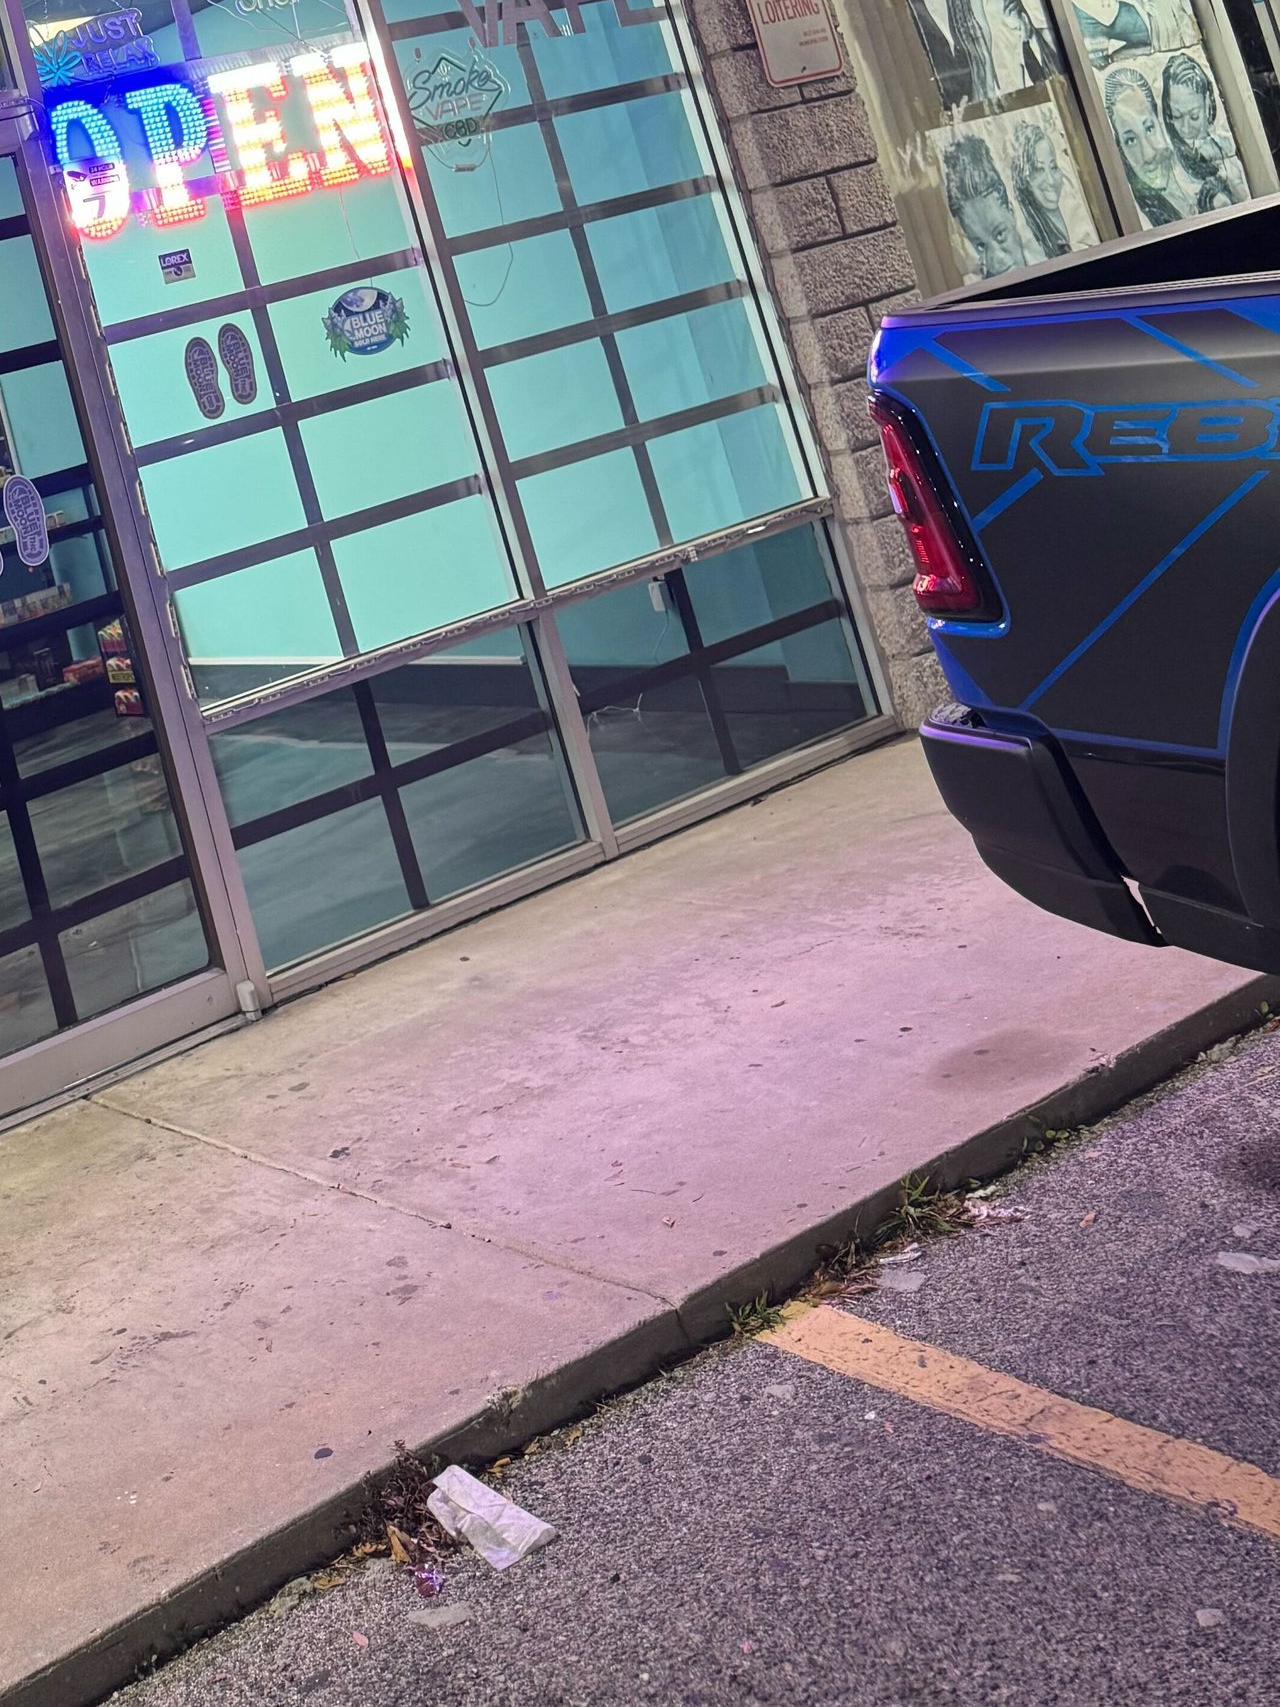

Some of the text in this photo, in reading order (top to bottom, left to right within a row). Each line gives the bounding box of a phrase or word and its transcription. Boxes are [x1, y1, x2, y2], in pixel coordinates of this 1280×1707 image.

[71, 12, 138, 48] JUST
[81, 39, 155, 75] RELAX
[407, 60, 503, 110] Smoke
[424, 93, 483, 121] VAPE
[51, 44, 395, 239] OPEN
[444, 117, 478, 139] CBD
[160, 252, 189, 267] LOREX
[351, 310, 385, 329] BLUE
[354, 322, 387, 340] MOON
[199, 356, 215, 391] BLUE
[226, 343, 240, 378] MOON
[232, 341, 249, 374] BLUE
[971, 397, 1280, 477] REB
[13, 497, 31, 537] MOON
[21, 494, 39, 533] BLUE
